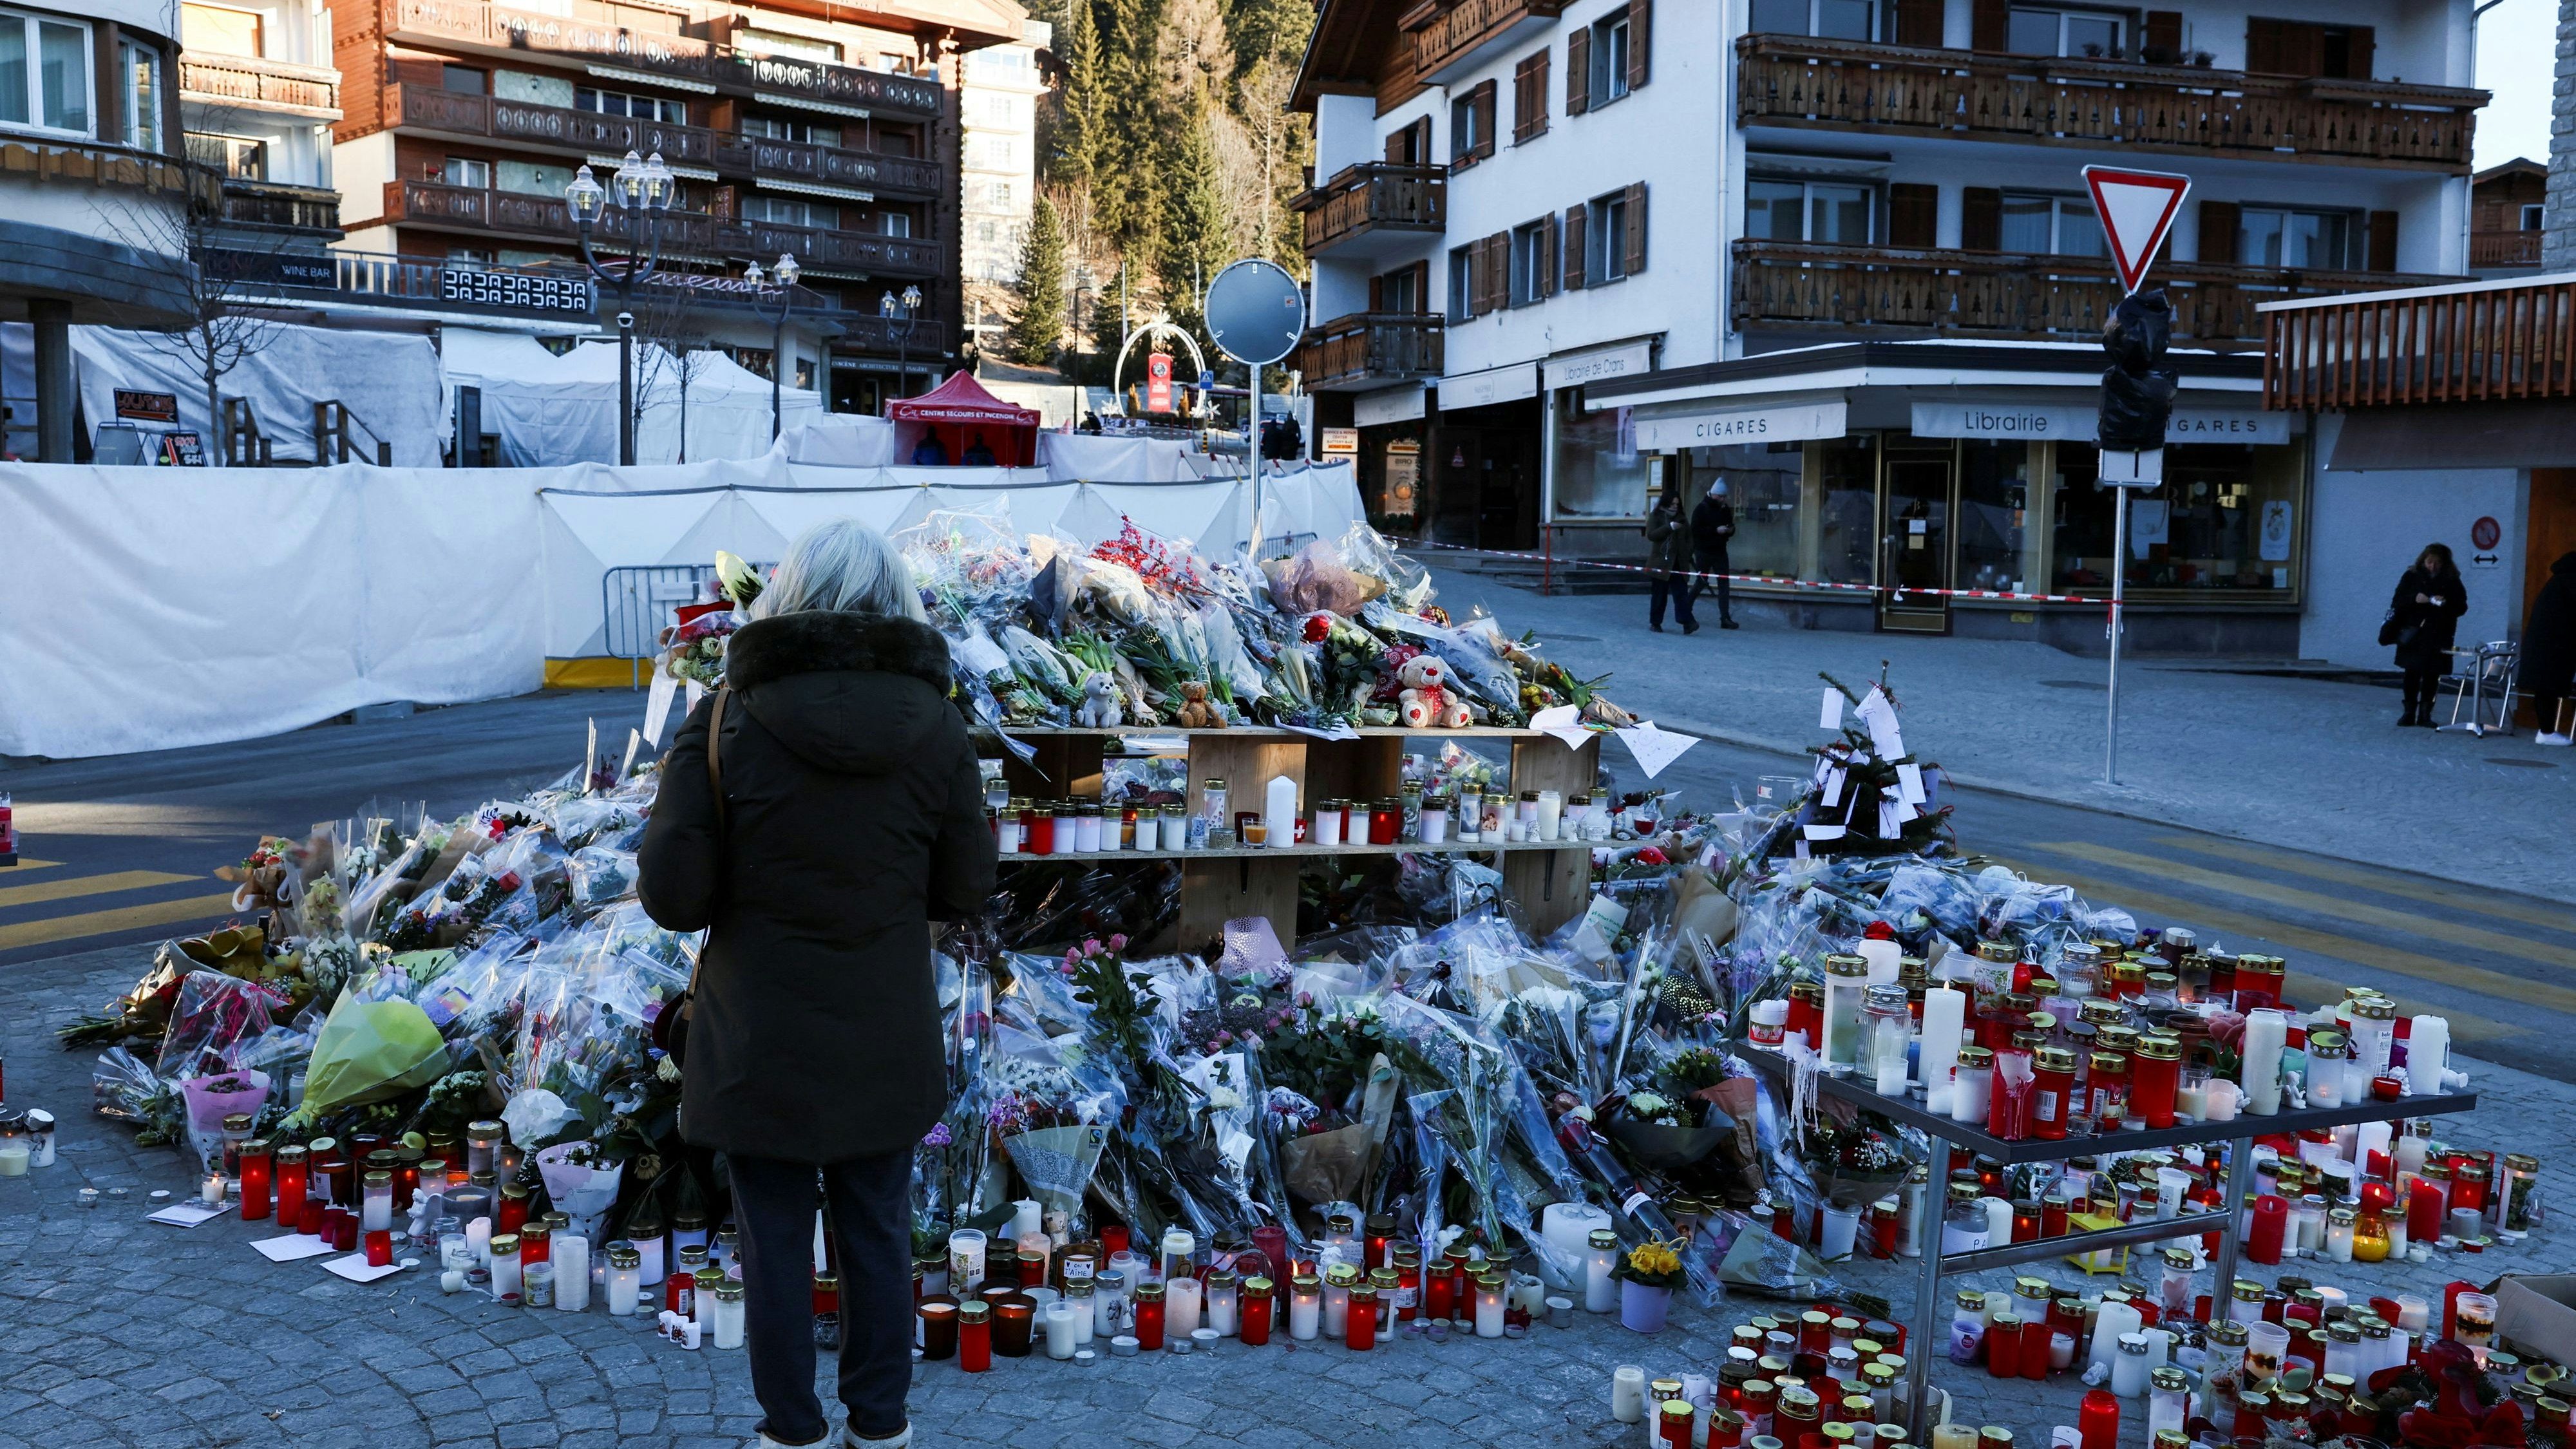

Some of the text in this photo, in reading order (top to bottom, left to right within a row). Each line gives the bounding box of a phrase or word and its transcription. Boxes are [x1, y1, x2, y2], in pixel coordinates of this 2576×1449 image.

[282, 265, 330, 278] WINE BAR
[1592, 361, 1602, 375] de
[1604, 359, 1625, 374] Crans
[1696, 419, 1767, 437] CIGARES
[1965, 412, 2257, 432] Librairie IGARES
